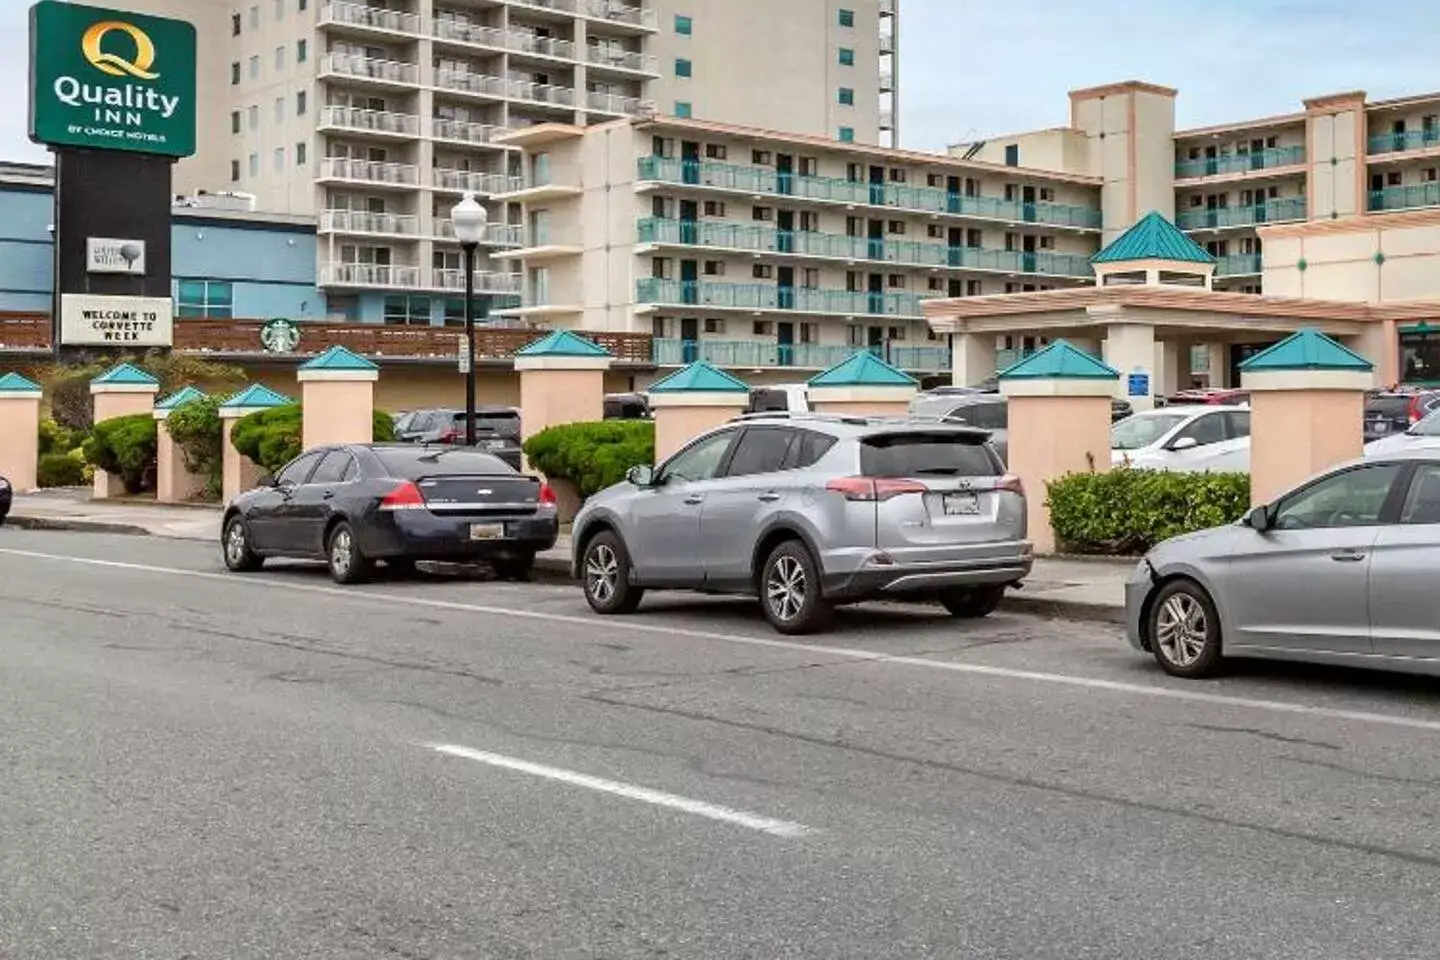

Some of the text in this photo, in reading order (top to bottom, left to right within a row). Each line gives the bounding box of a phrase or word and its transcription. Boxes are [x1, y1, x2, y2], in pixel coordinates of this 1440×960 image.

[53, 76, 180, 118] Quality
[95, 107, 142, 126] INN
[67, 124, 83, 134] BY
[84, 127, 125, 139] CHOICE
[82, 310, 157, 322] WELCOME TO
[92, 321, 153, 331] CORVETTE
[104, 331, 140, 341] WEEK
